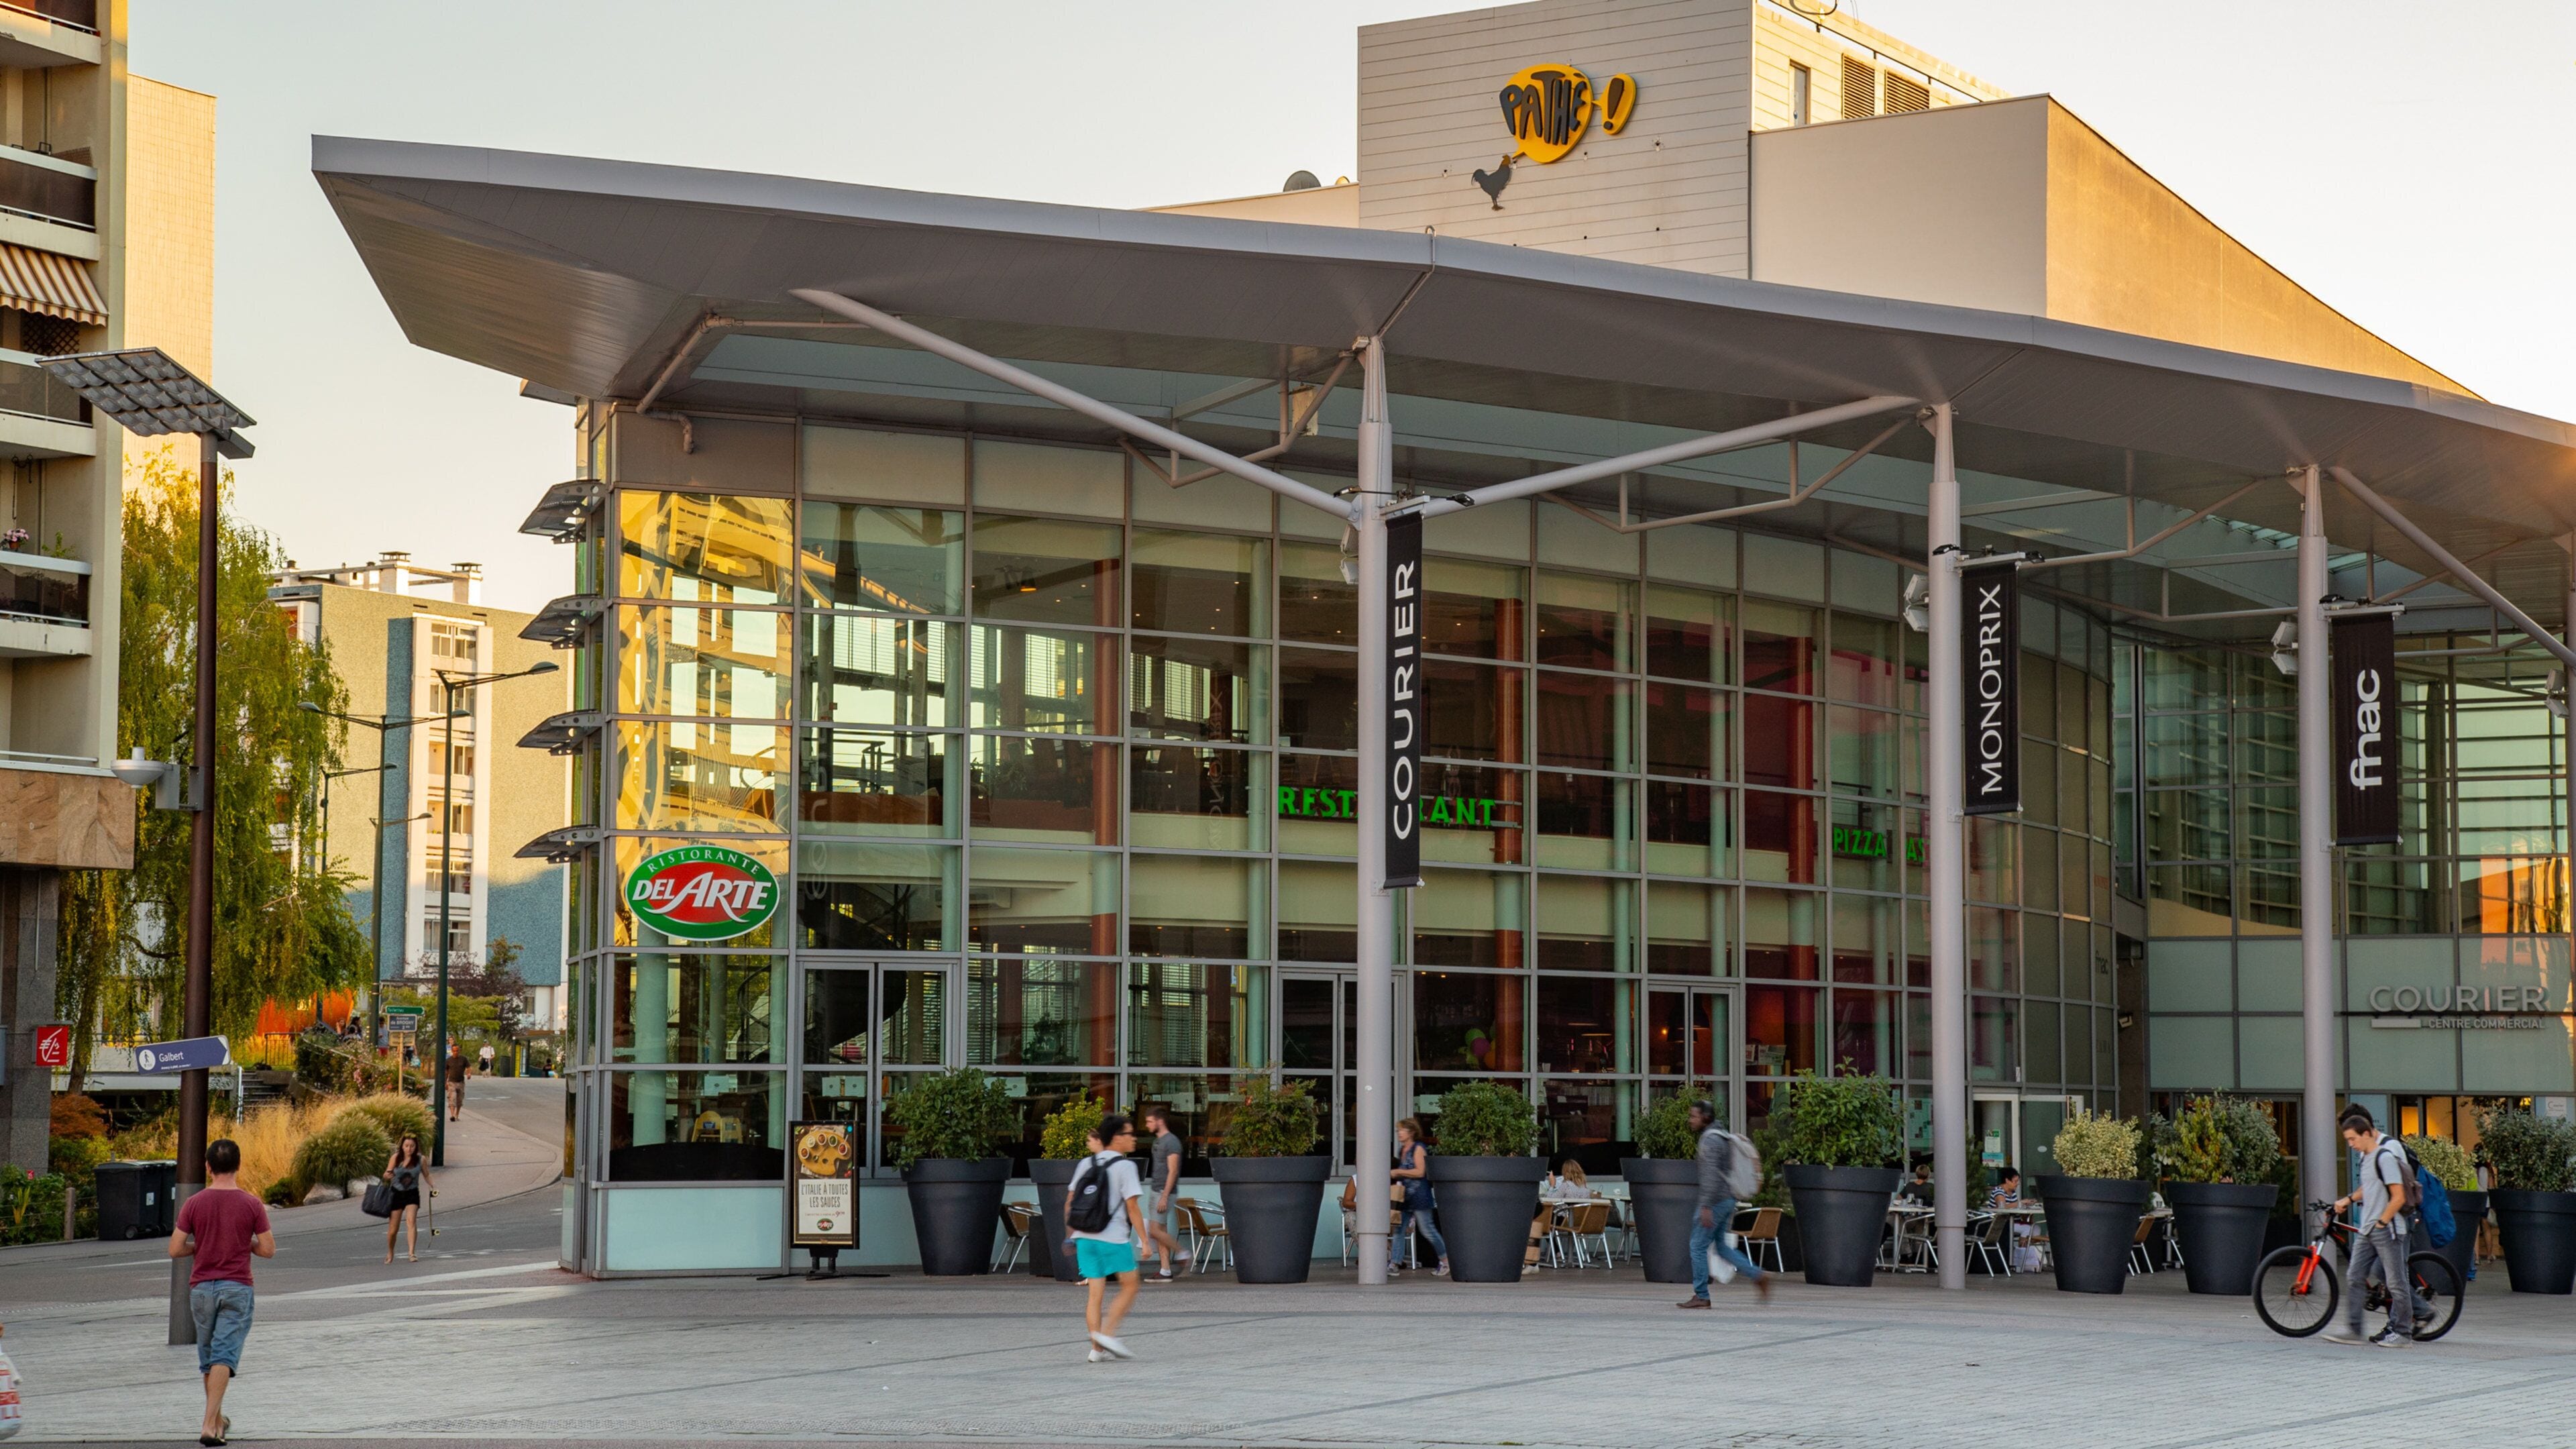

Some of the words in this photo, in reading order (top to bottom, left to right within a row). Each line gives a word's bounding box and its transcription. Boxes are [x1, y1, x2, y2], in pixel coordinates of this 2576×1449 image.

[1394, 560, 1414, 840] COURIER
[1980, 584, 2002, 795] MONOPRIX
[2350, 669, 2382, 790] fnac
[1278, 786, 1495, 826] RESTANT
[1833, 826, 1886, 857] PIZZA
[647, 849, 760, 875] RISTORANTE
[632, 878, 675, 901] DEL
[642, 871, 771, 923] ARTE
[2369, 985, 2546, 1012] COURIER
[2428, 1018, 2471, 1028] CENTRE
[2473, 1018, 2546, 1028] COMMERCIAL
[158, 1051, 184, 1062] Galbert
[801, 1184, 821, 1195] L'ITALIE
[828, 1183, 848, 1195] TOUTES
[810, 1197, 818, 1208] LES
[820, 1196, 841, 1208] SAUCES
